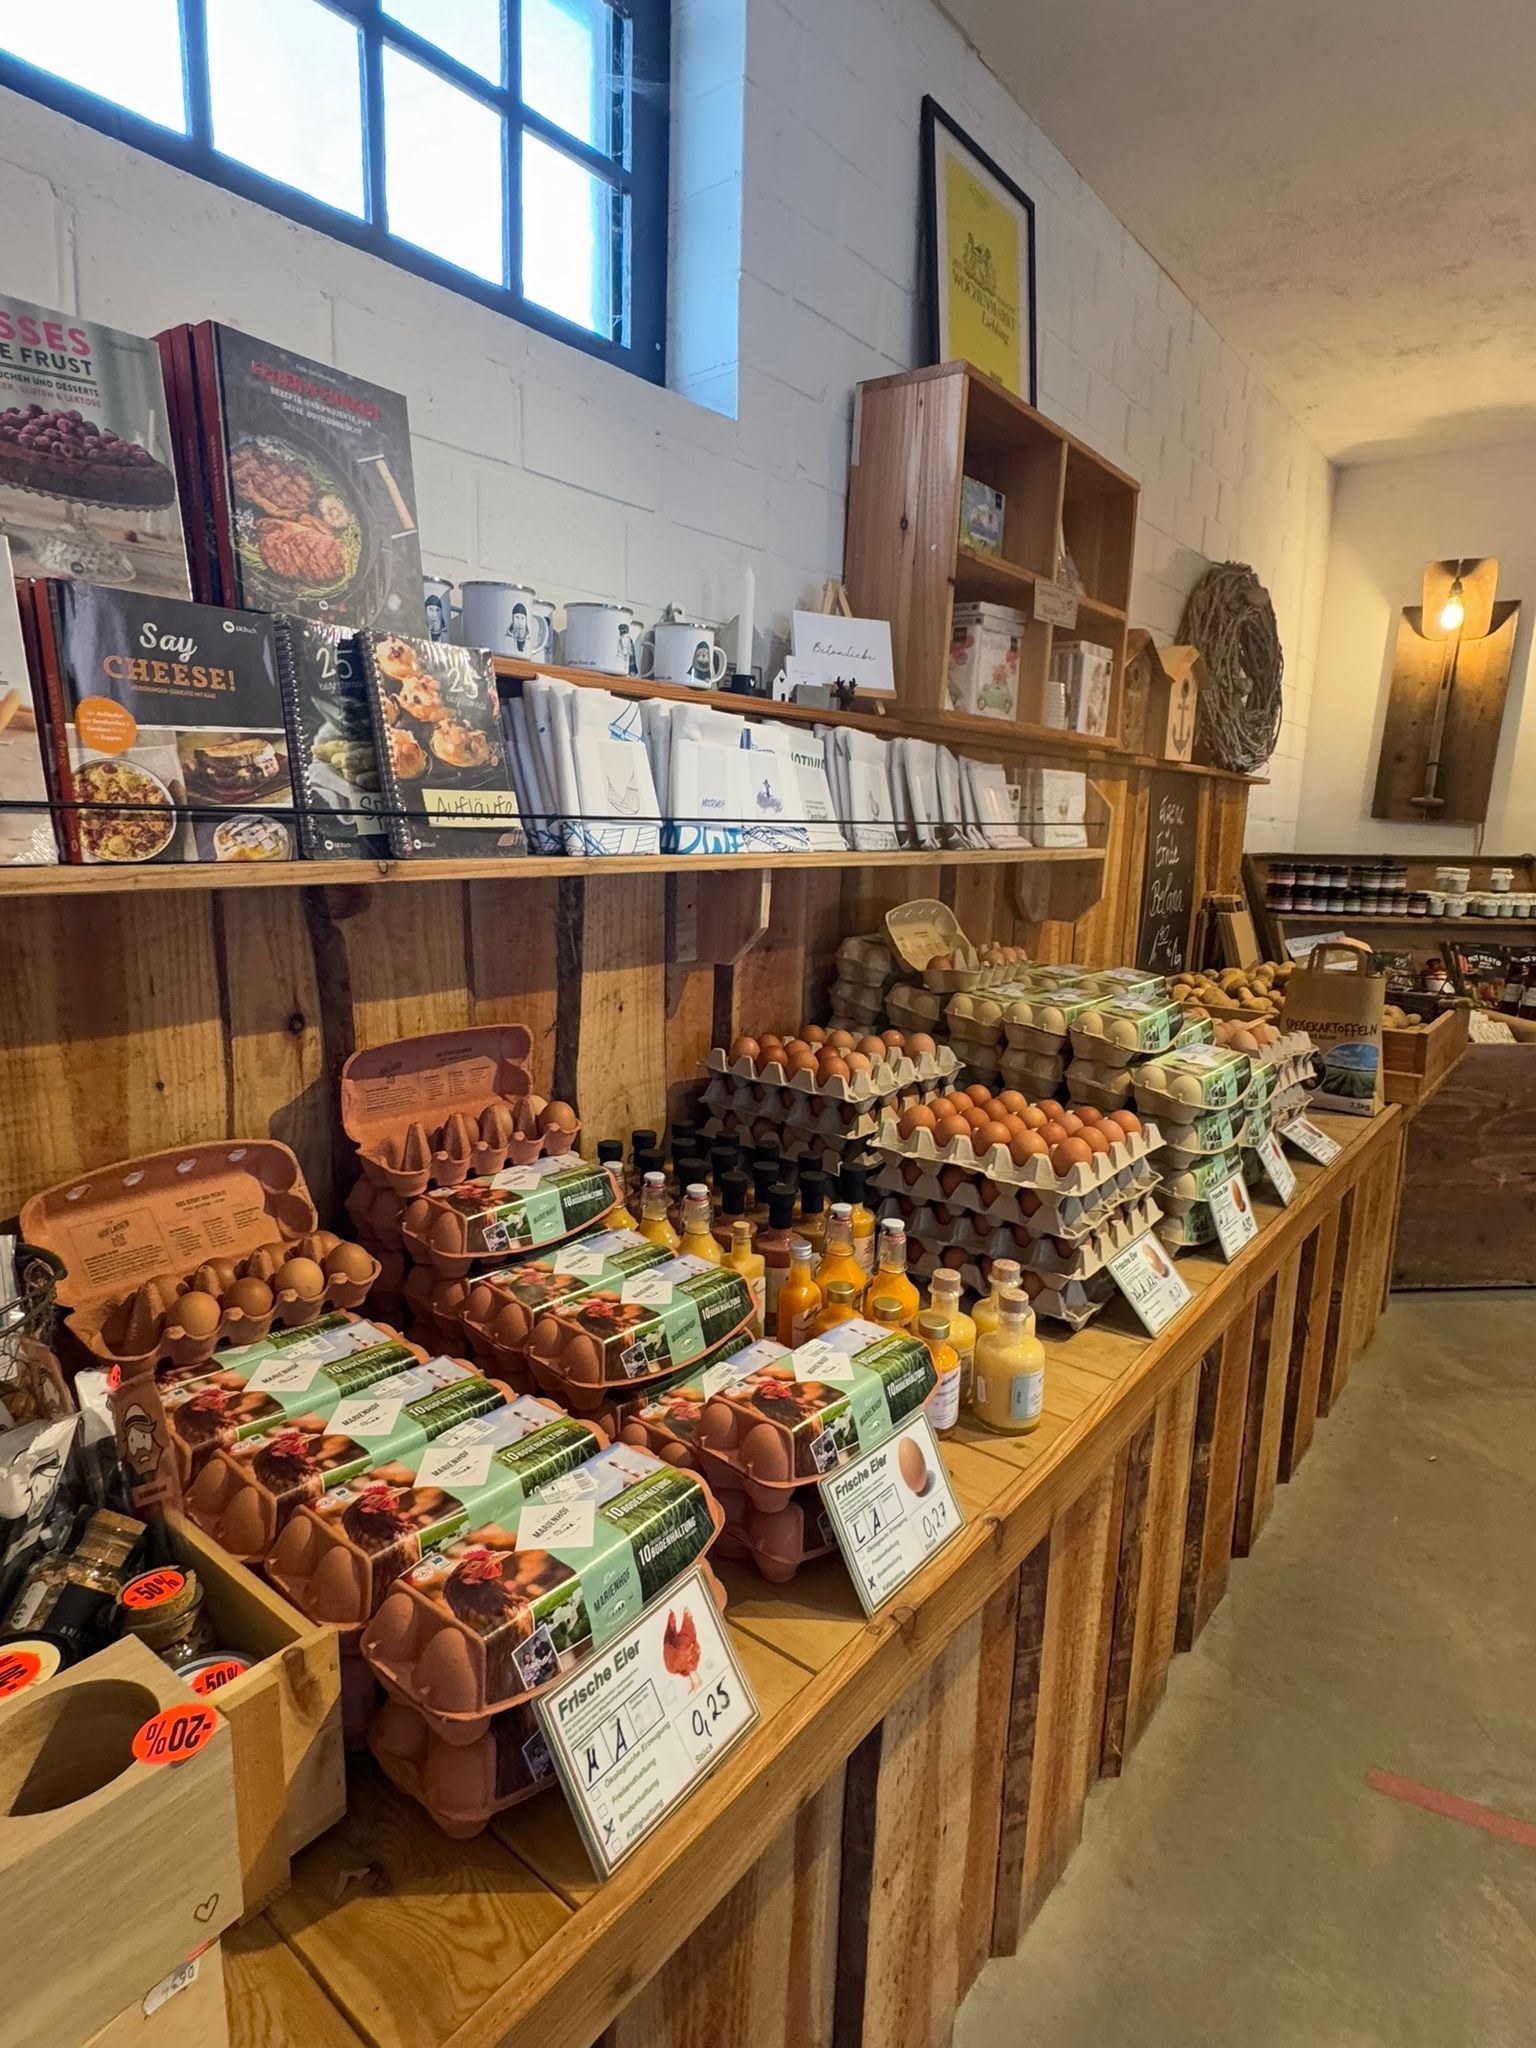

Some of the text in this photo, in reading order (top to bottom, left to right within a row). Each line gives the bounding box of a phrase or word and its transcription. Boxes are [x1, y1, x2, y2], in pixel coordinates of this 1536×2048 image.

[19, 346, 93, 376] FRUST
[33, 376, 55, 389] UND
[55, 382, 100, 398] DESSERTS
[139, 622, 199, 663] Say
[103, 654, 236, 692] CHEESE!
[315, 646, 354, 680] 25
[447, 666, 482, 700] 25
[701, 1306, 711, 1321] 10
[260, 1362, 300, 1386] MARIENHOF
[325, 1364, 343, 1376] 10
[408, 1384, 478, 1418] 10 BODENHALTUNG
[886, 1381, 896, 1399] 10
[340, 1401, 381, 1427] MARIENHOF
[500, 1426, 570, 1465] 10 BODENHALTUNG
[430, 1448, 471, 1478] MARIENHOF
[835, 1468, 869, 1500] Frische
[869, 1453, 887, 1474] Eier
[605, 1477, 673, 1521] 10 BODENHALTUNG
[531, 1506, 570, 1540] MARIENHOF
[873, 1507, 881, 1537] A
[638, 1515, 698, 1567] 10 BODENHALTUNG
[129, 1573, 181, 1603] -50%
[593, 1565, 632, 1614] MARIENHOF
[557, 1666, 613, 1722] Frische
[613, 1639, 641, 1673] Eier
[691, 1675, 734, 1738] 0,25
[145, 1712, 213, 1759] -20%
[616, 1716, 629, 1762] A
